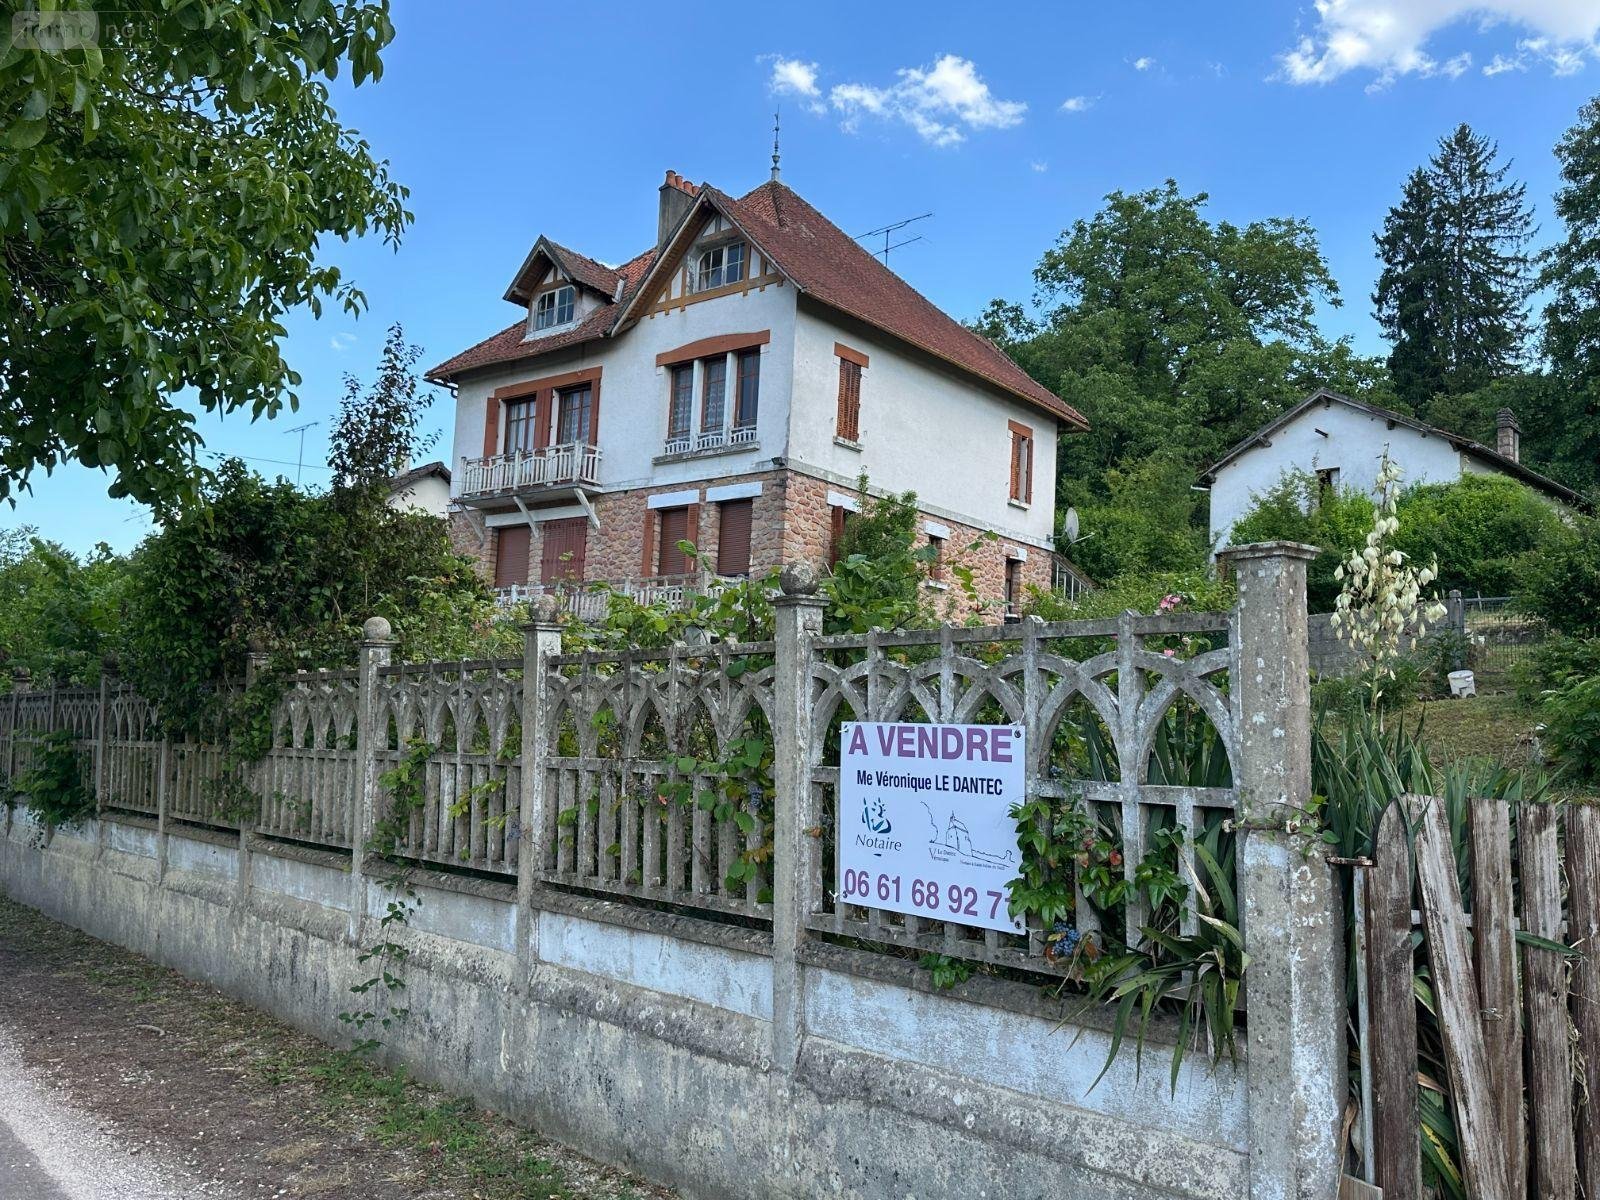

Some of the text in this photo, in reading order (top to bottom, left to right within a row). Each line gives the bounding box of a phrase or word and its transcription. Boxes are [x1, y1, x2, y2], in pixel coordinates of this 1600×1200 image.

[848, 724, 1013, 763] A VENDRE
[856, 769, 1003, 796] Me Véronique LE DANTEC
[855, 833, 902, 852] Notaire
[844, 868, 870, 898] 06
[877, 873, 901, 903] 61
[911, 878, 940, 910] 68
[948, 884, 978, 917] 92
